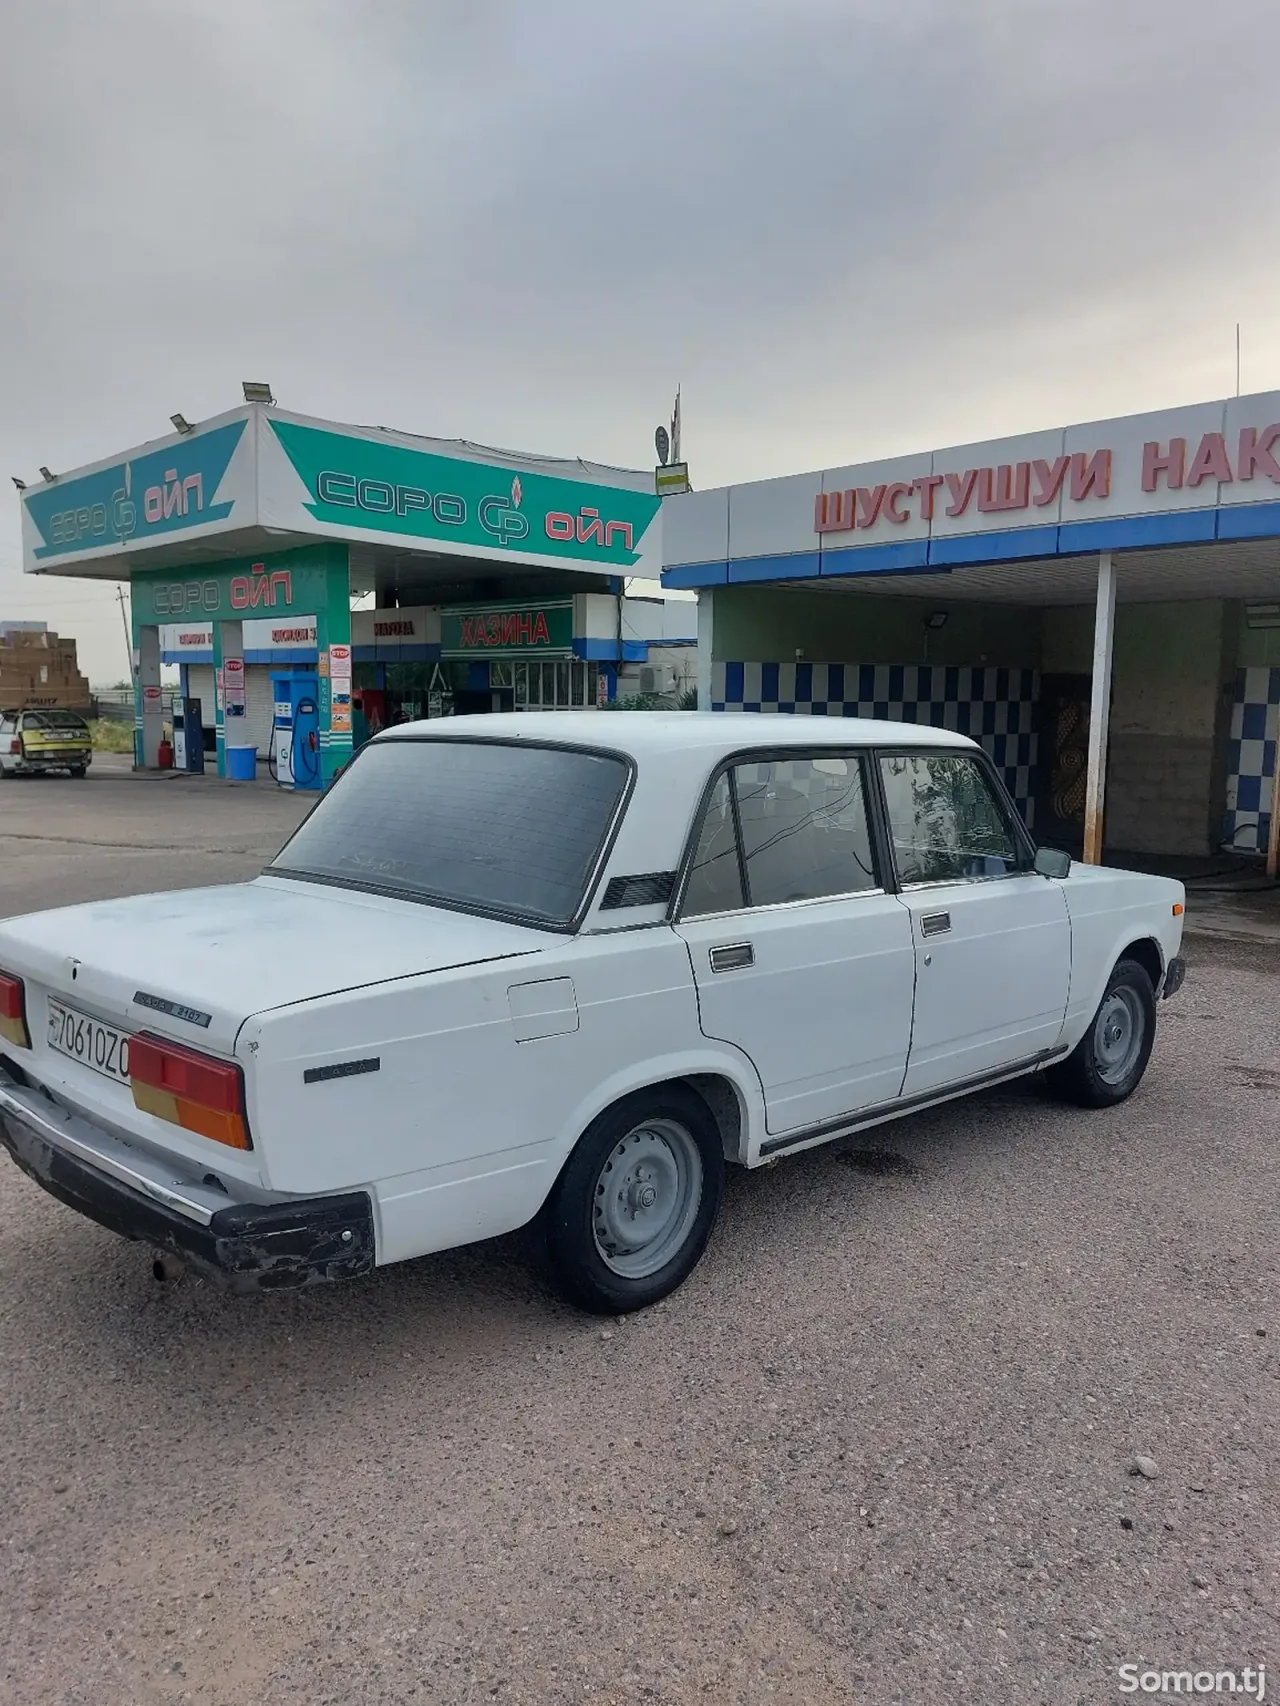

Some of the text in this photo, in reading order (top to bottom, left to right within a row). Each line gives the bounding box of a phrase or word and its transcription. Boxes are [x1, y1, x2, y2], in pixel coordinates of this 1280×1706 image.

[459, 611, 550, 647] ХАЗИНА
[331, 650, 349, 658] STOP
[226, 662, 242, 670] STOP
[176, 1006, 201, 1022] 2107
